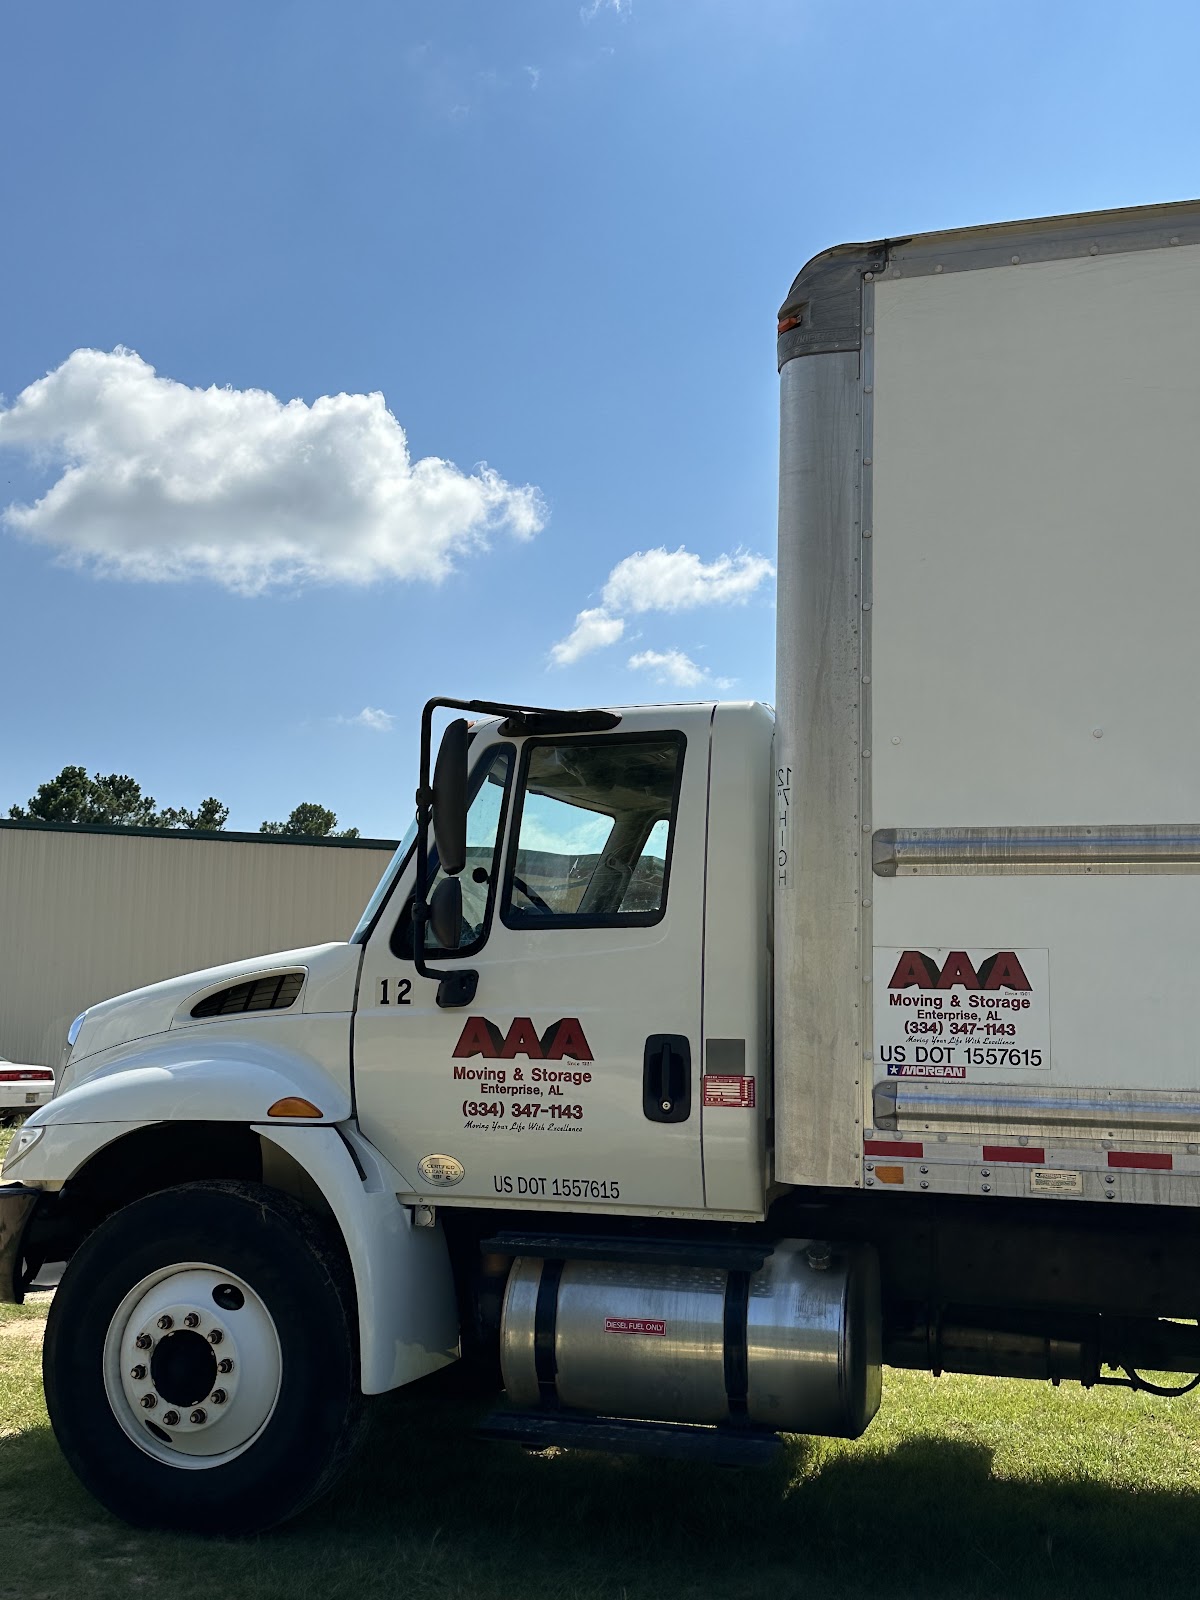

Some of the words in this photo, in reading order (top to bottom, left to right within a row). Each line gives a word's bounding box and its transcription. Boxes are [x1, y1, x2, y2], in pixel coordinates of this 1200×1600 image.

[887, 951, 1033, 991] AAA
[380, 978, 412, 1005] 12
[889, 994, 943, 1009] Moving
[950, 995, 961, 1007] &
[969, 995, 1031, 1011] Storage
[917, 1010, 981, 1021] Enterprise,
[986, 1011, 1002, 1020] AL
[904, 1021, 943, 1035] (334)
[950, 1023, 1016, 1035] 347-1143
[452, 1016, 594, 1060] AAA
[880, 1045, 906, 1062] US
[915, 1046, 955, 1063] DOT
[964, 1049, 1042, 1066] 1557615
[454, 1067, 506, 1082] Moving
[514, 1068, 523, 1081] &
[531, 1068, 592, 1084] Storage
[901, 1066, 964, 1077] MORGAN
[481, 1083, 543, 1096] Enterprise,
[548, 1085, 563, 1095] AL
[462, 1100, 505, 1118] (334)
[511, 1103, 583, 1119] 347-1143
[464, 1121, 489, 1131] Moving
[492, 1122, 508, 1132] Your
[509, 1122, 525, 1133] Life
[528, 1123, 545, 1131] With
[547, 1123, 583, 1132] Excellence
[494, 1175, 513, 1193] US
[518, 1178, 547, 1195] DOT
[552, 1179, 620, 1199] 1557615
